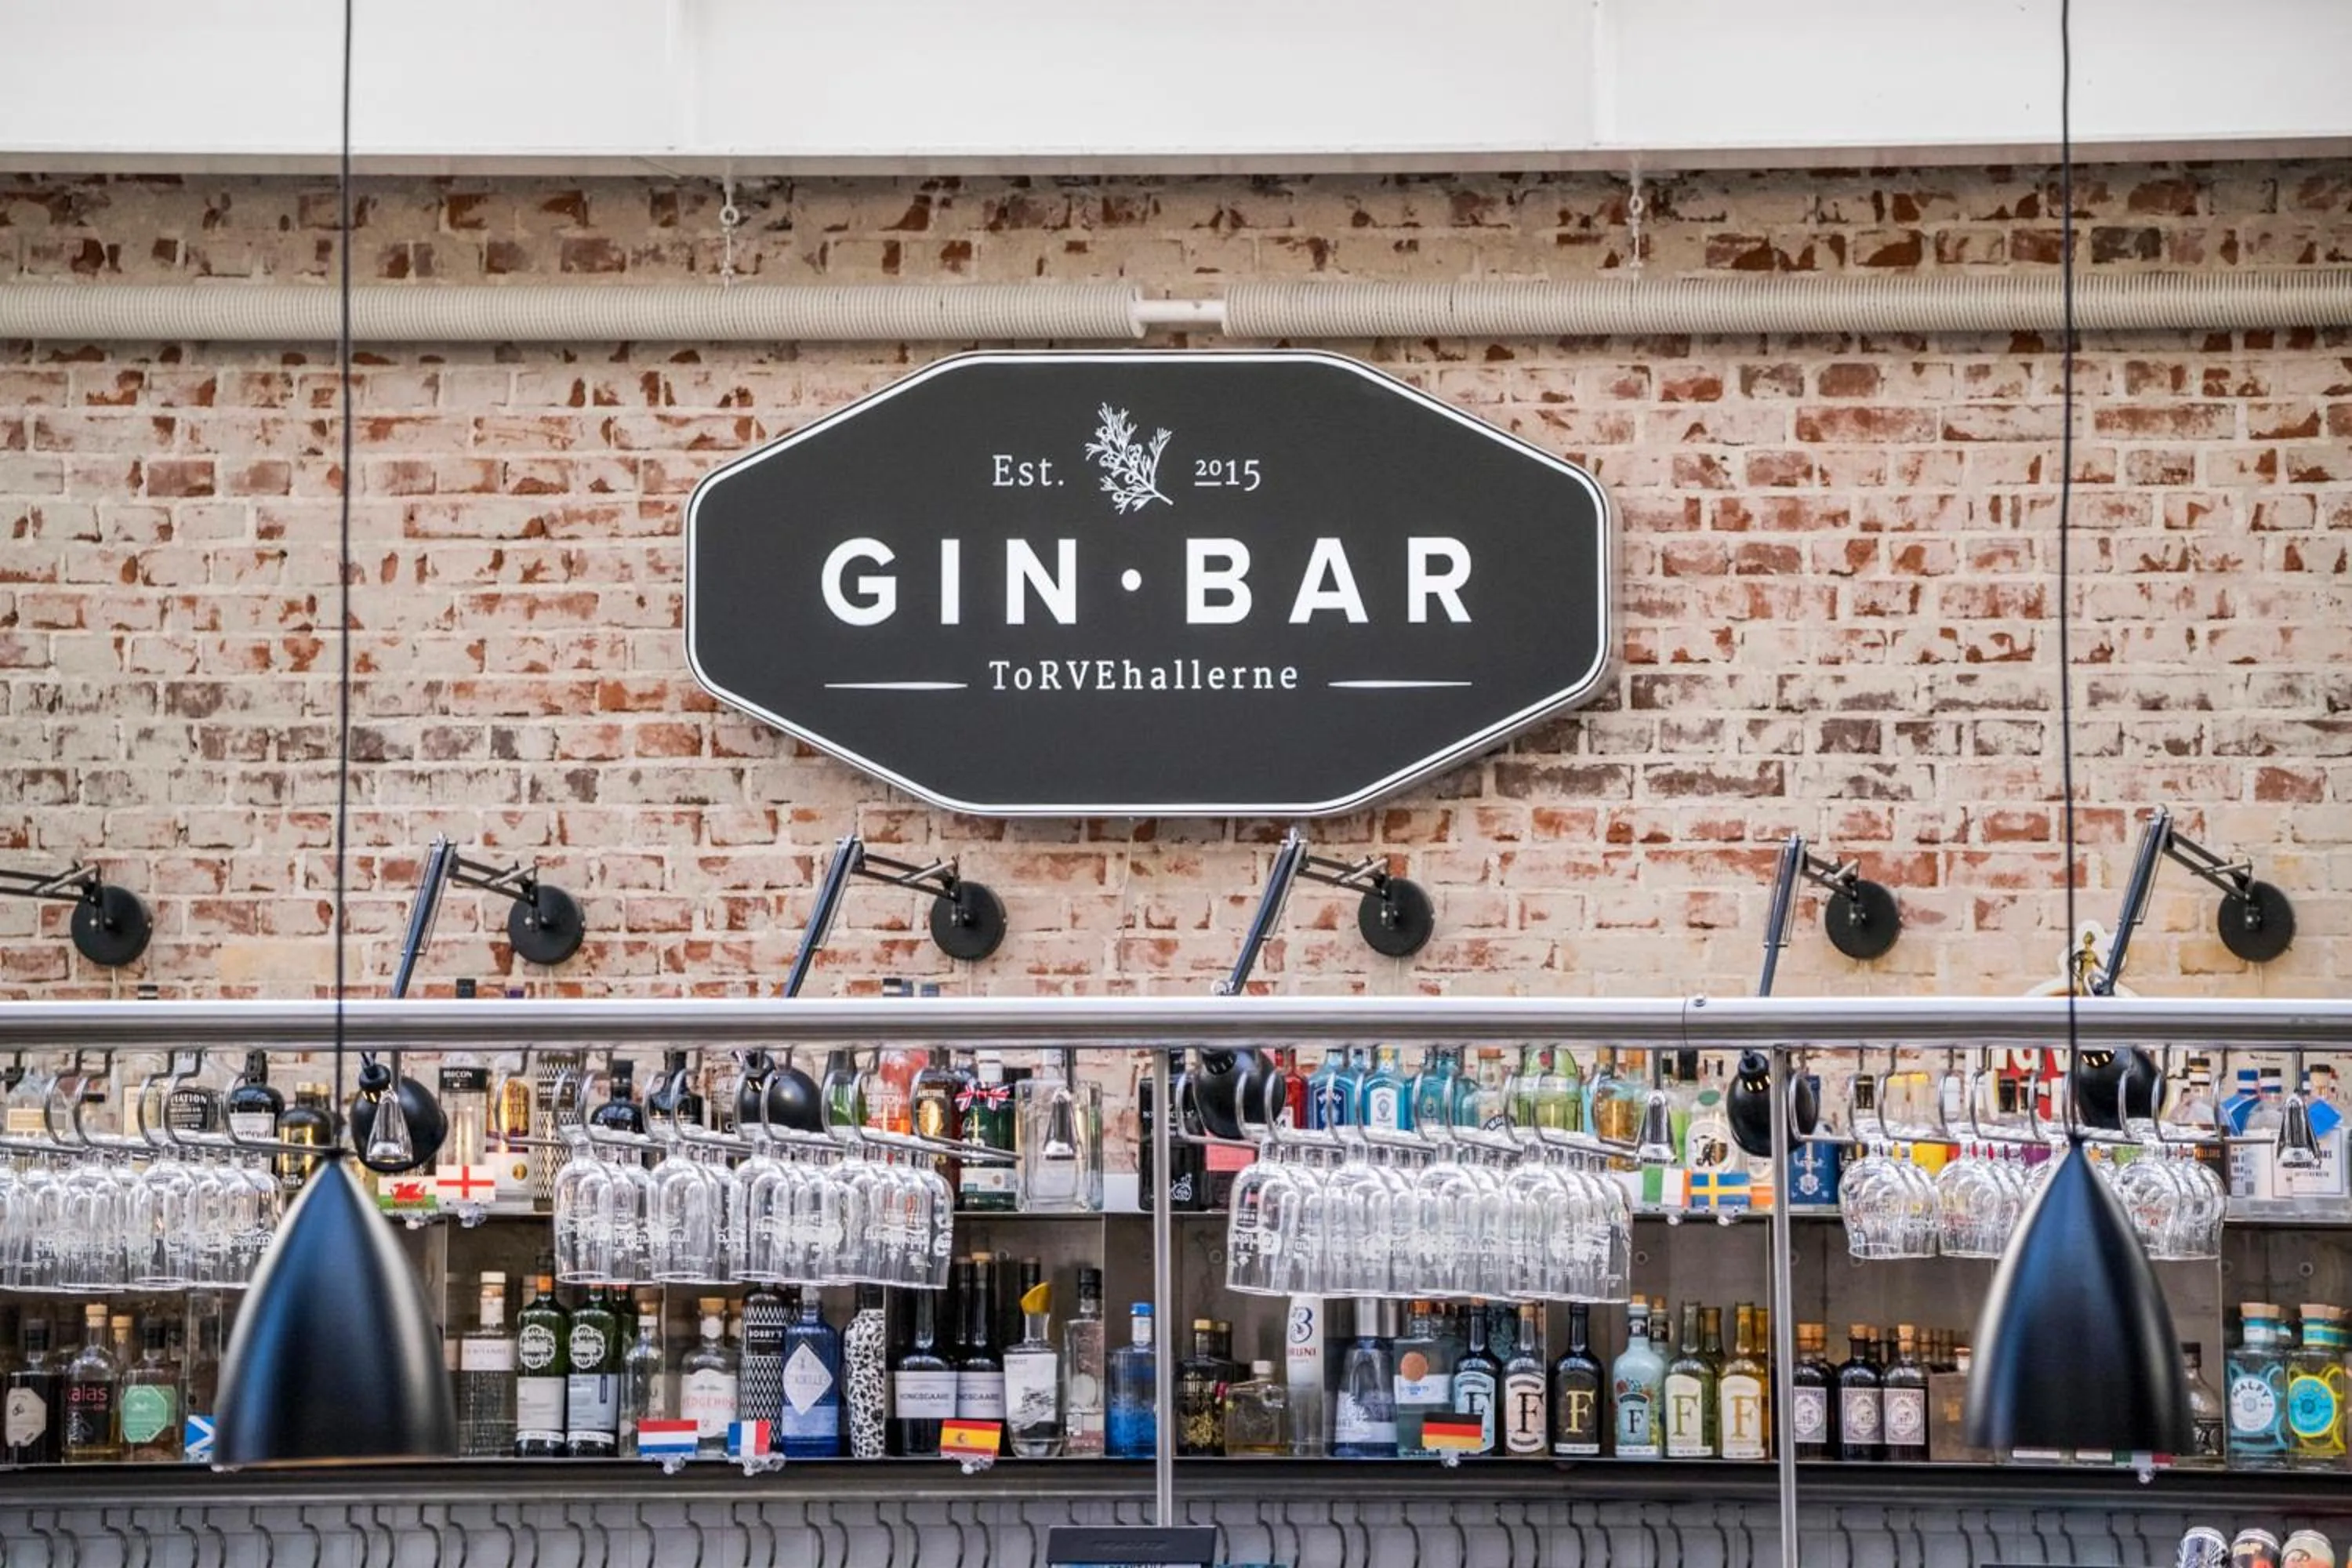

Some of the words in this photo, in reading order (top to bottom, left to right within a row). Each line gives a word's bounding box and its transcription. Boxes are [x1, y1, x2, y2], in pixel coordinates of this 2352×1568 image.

[993, 455, 1064, 488] Est.
[1194, 459, 1261, 492] 2015
[822, 538, 1078, 625] GIN
[1186, 538, 1472, 624] BAR
[989, 658, 1298, 691] ToRVEhallerne
[170, 1093, 208, 1105] IATION
[1515, 1392, 1544, 1434] F
[1565, 1389, 1595, 1434] F
[1628, 1409, 1644, 1434] F
[1670, 1394, 1699, 1437] F
[1730, 1395, 1759, 1439] F
